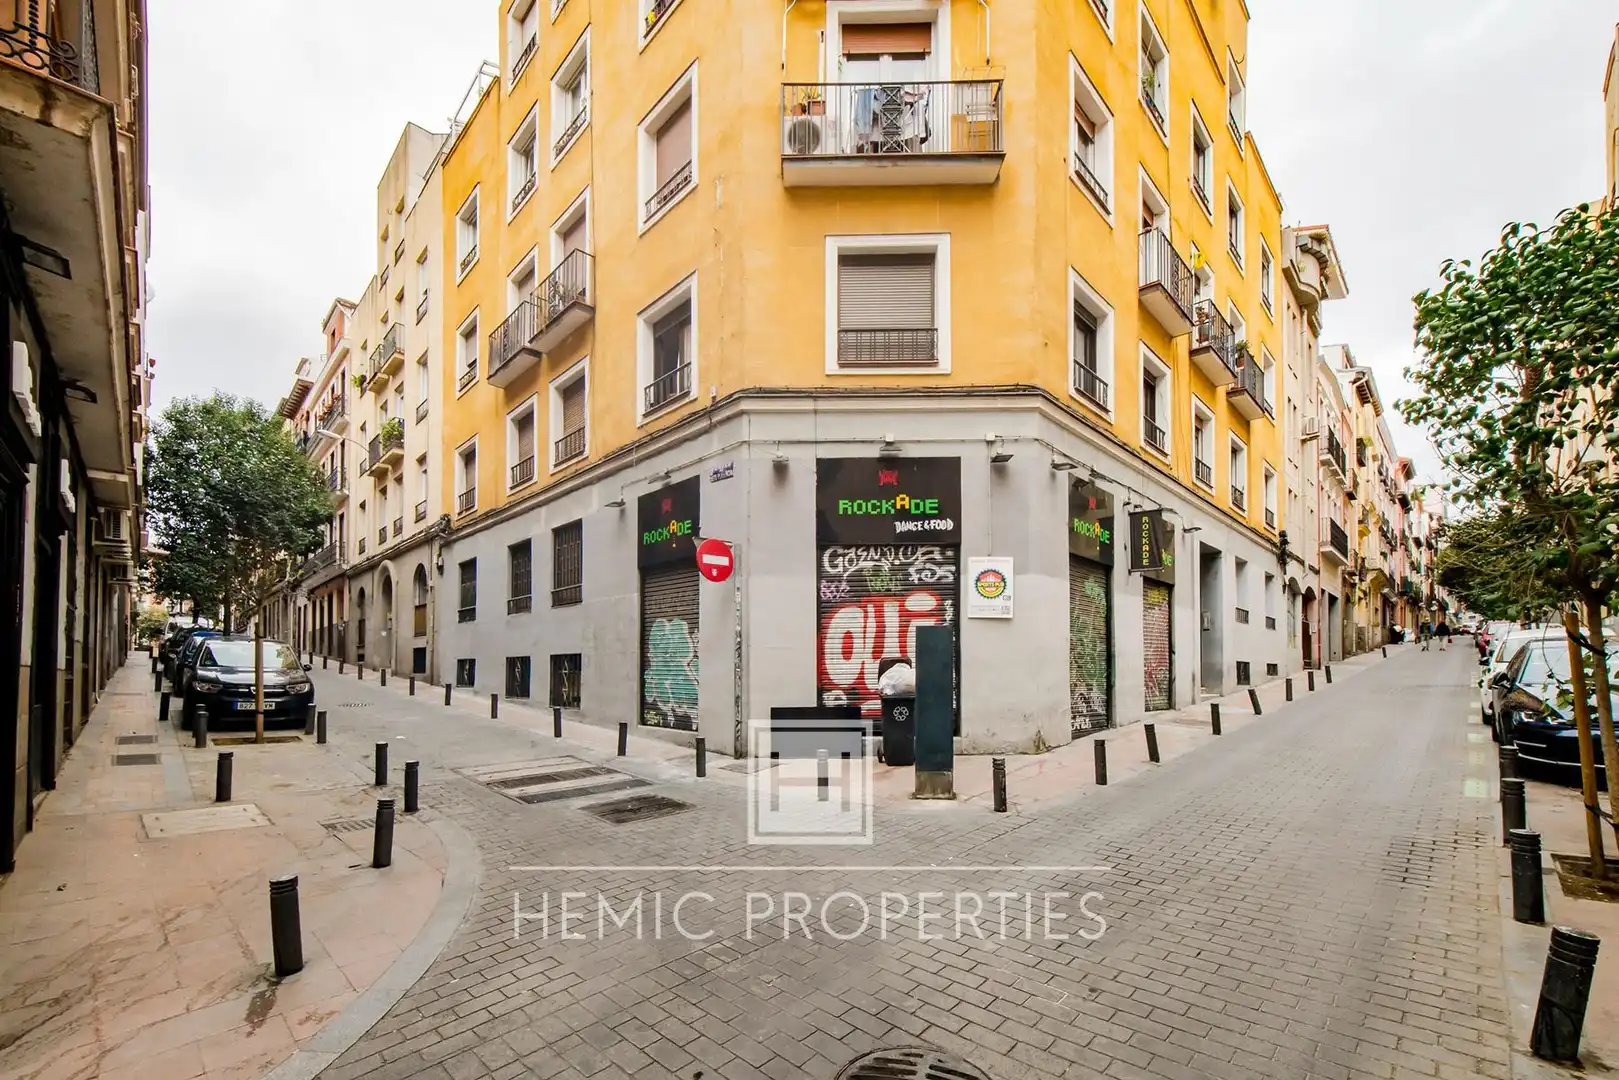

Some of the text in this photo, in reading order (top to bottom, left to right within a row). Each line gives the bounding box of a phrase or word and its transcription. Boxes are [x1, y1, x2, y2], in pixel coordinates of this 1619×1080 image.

[838, 494, 939, 515] ROCKADE
[643, 520, 692, 545] ROCKADE
[1074, 517, 1110, 544] ROCKADE
[1142, 516, 1150, 566] ROCKADE
